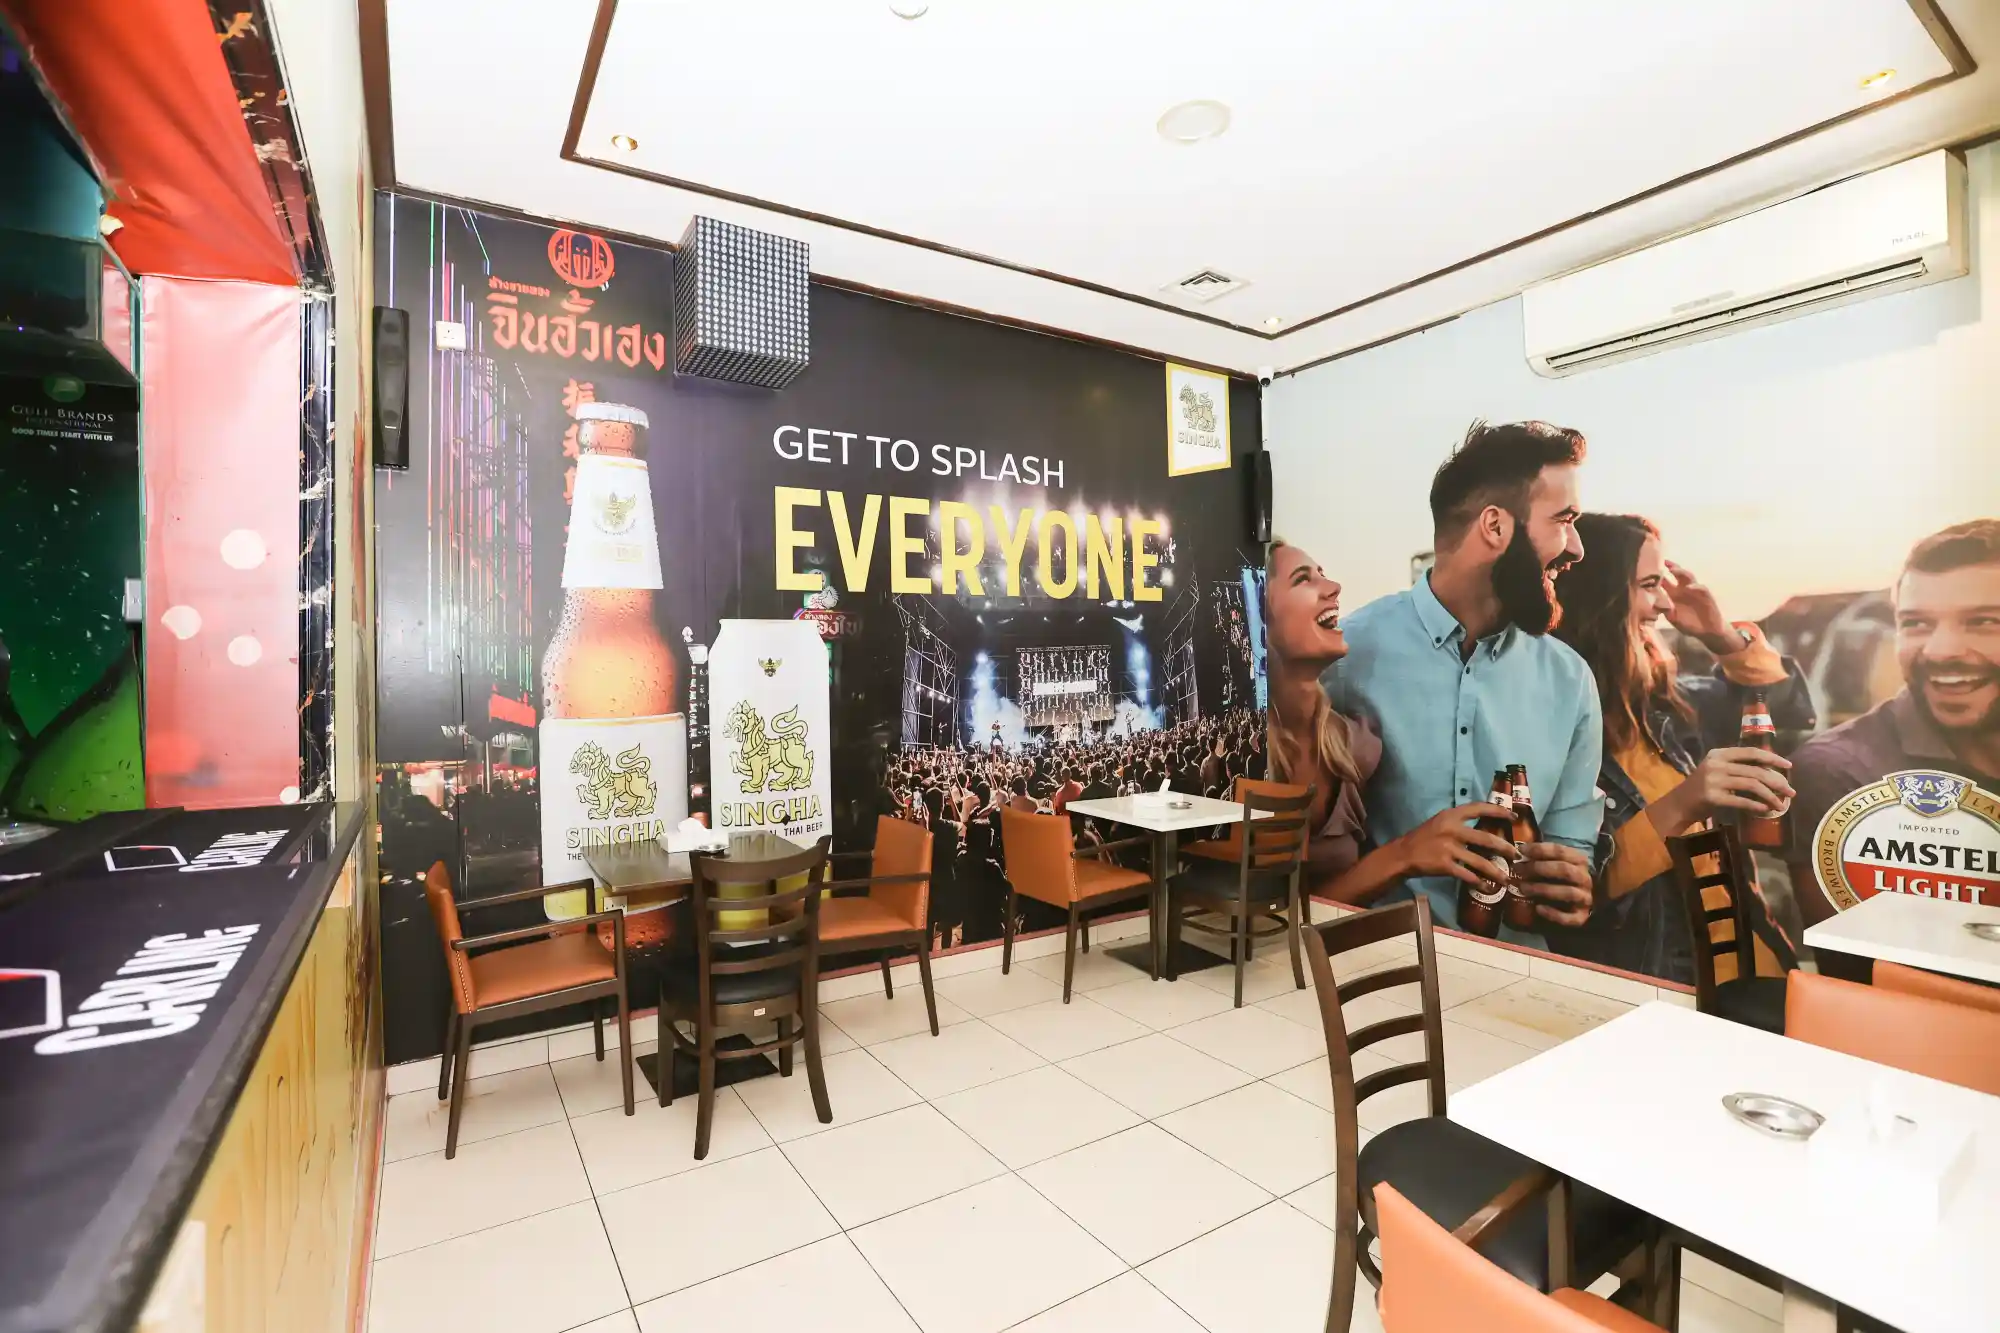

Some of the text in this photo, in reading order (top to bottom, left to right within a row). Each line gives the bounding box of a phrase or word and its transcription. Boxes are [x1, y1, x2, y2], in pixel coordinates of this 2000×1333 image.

[57, 408, 114, 422] BRANDS
[12, 427, 34, 436] GOOD
[36, 429, 59, 437] TIMES
[60, 431, 81, 439] START
[83, 433, 102, 441] WITH
[1178, 430, 1221, 450] SINGHA
[772, 424, 1064, 488] GET TO SPLASH
[774, 486, 1163, 602] EVERYONE
[1922, 779, 1935, 793] A
[720, 795, 823, 828] SINGHA
[1834, 788, 2000, 827] AMSTEL LA
[566, 819, 666, 849] SINGHA
[784, 825, 803, 837] THAI
[806, 821, 823, 833] BEER
[1898, 822, 1960, 836] IMPORTED
[178, 828, 290, 873] CARLING
[567, 852, 583, 861] THE
[1858, 836, 2000, 875] AMSTEL
[1874, 869, 1985, 905] LIGHT
[34, 923, 261, 1056] CARLING
